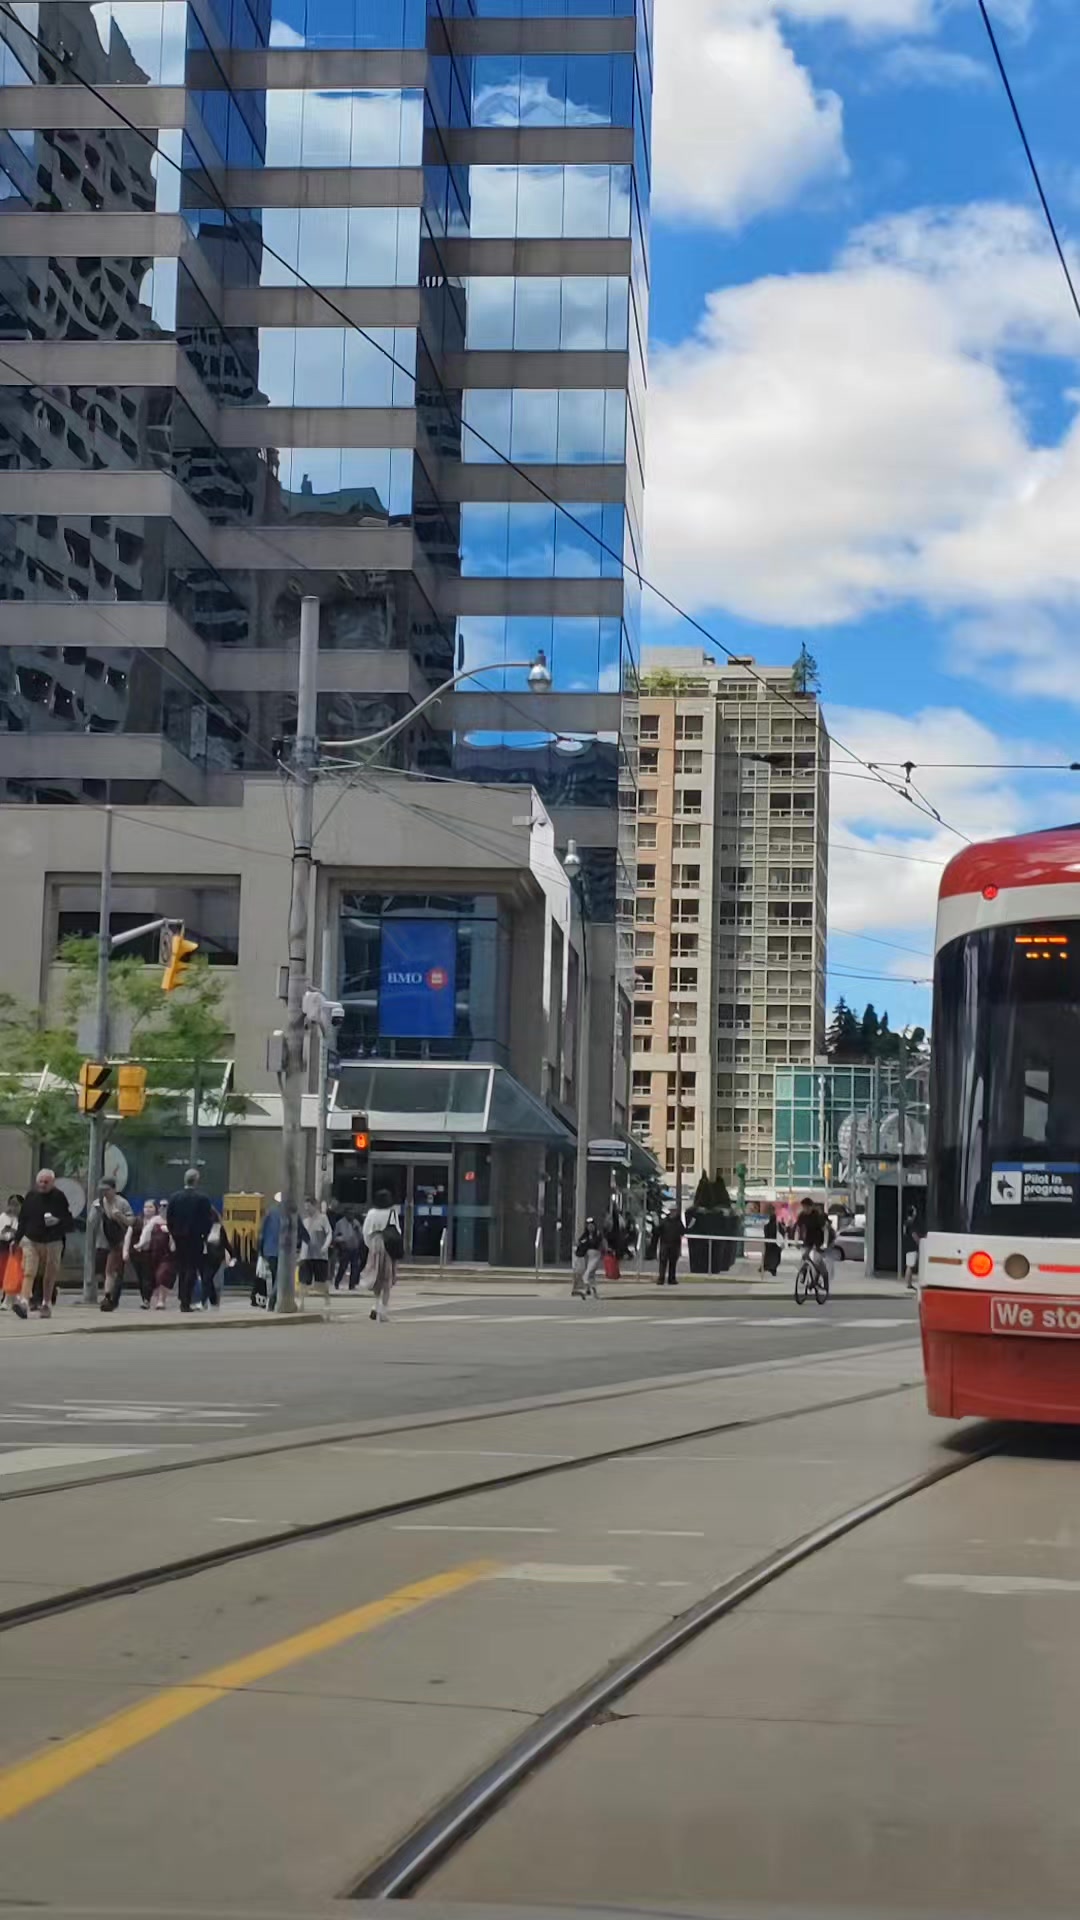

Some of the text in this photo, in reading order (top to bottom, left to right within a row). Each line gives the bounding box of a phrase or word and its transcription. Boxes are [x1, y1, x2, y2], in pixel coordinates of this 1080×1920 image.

[387, 972, 423, 984] BMO
[1024, 1173, 1050, 1185] Pilot
[1024, 1185, 1073, 1197] progress
[996, 1303, 1034, 1328] We
